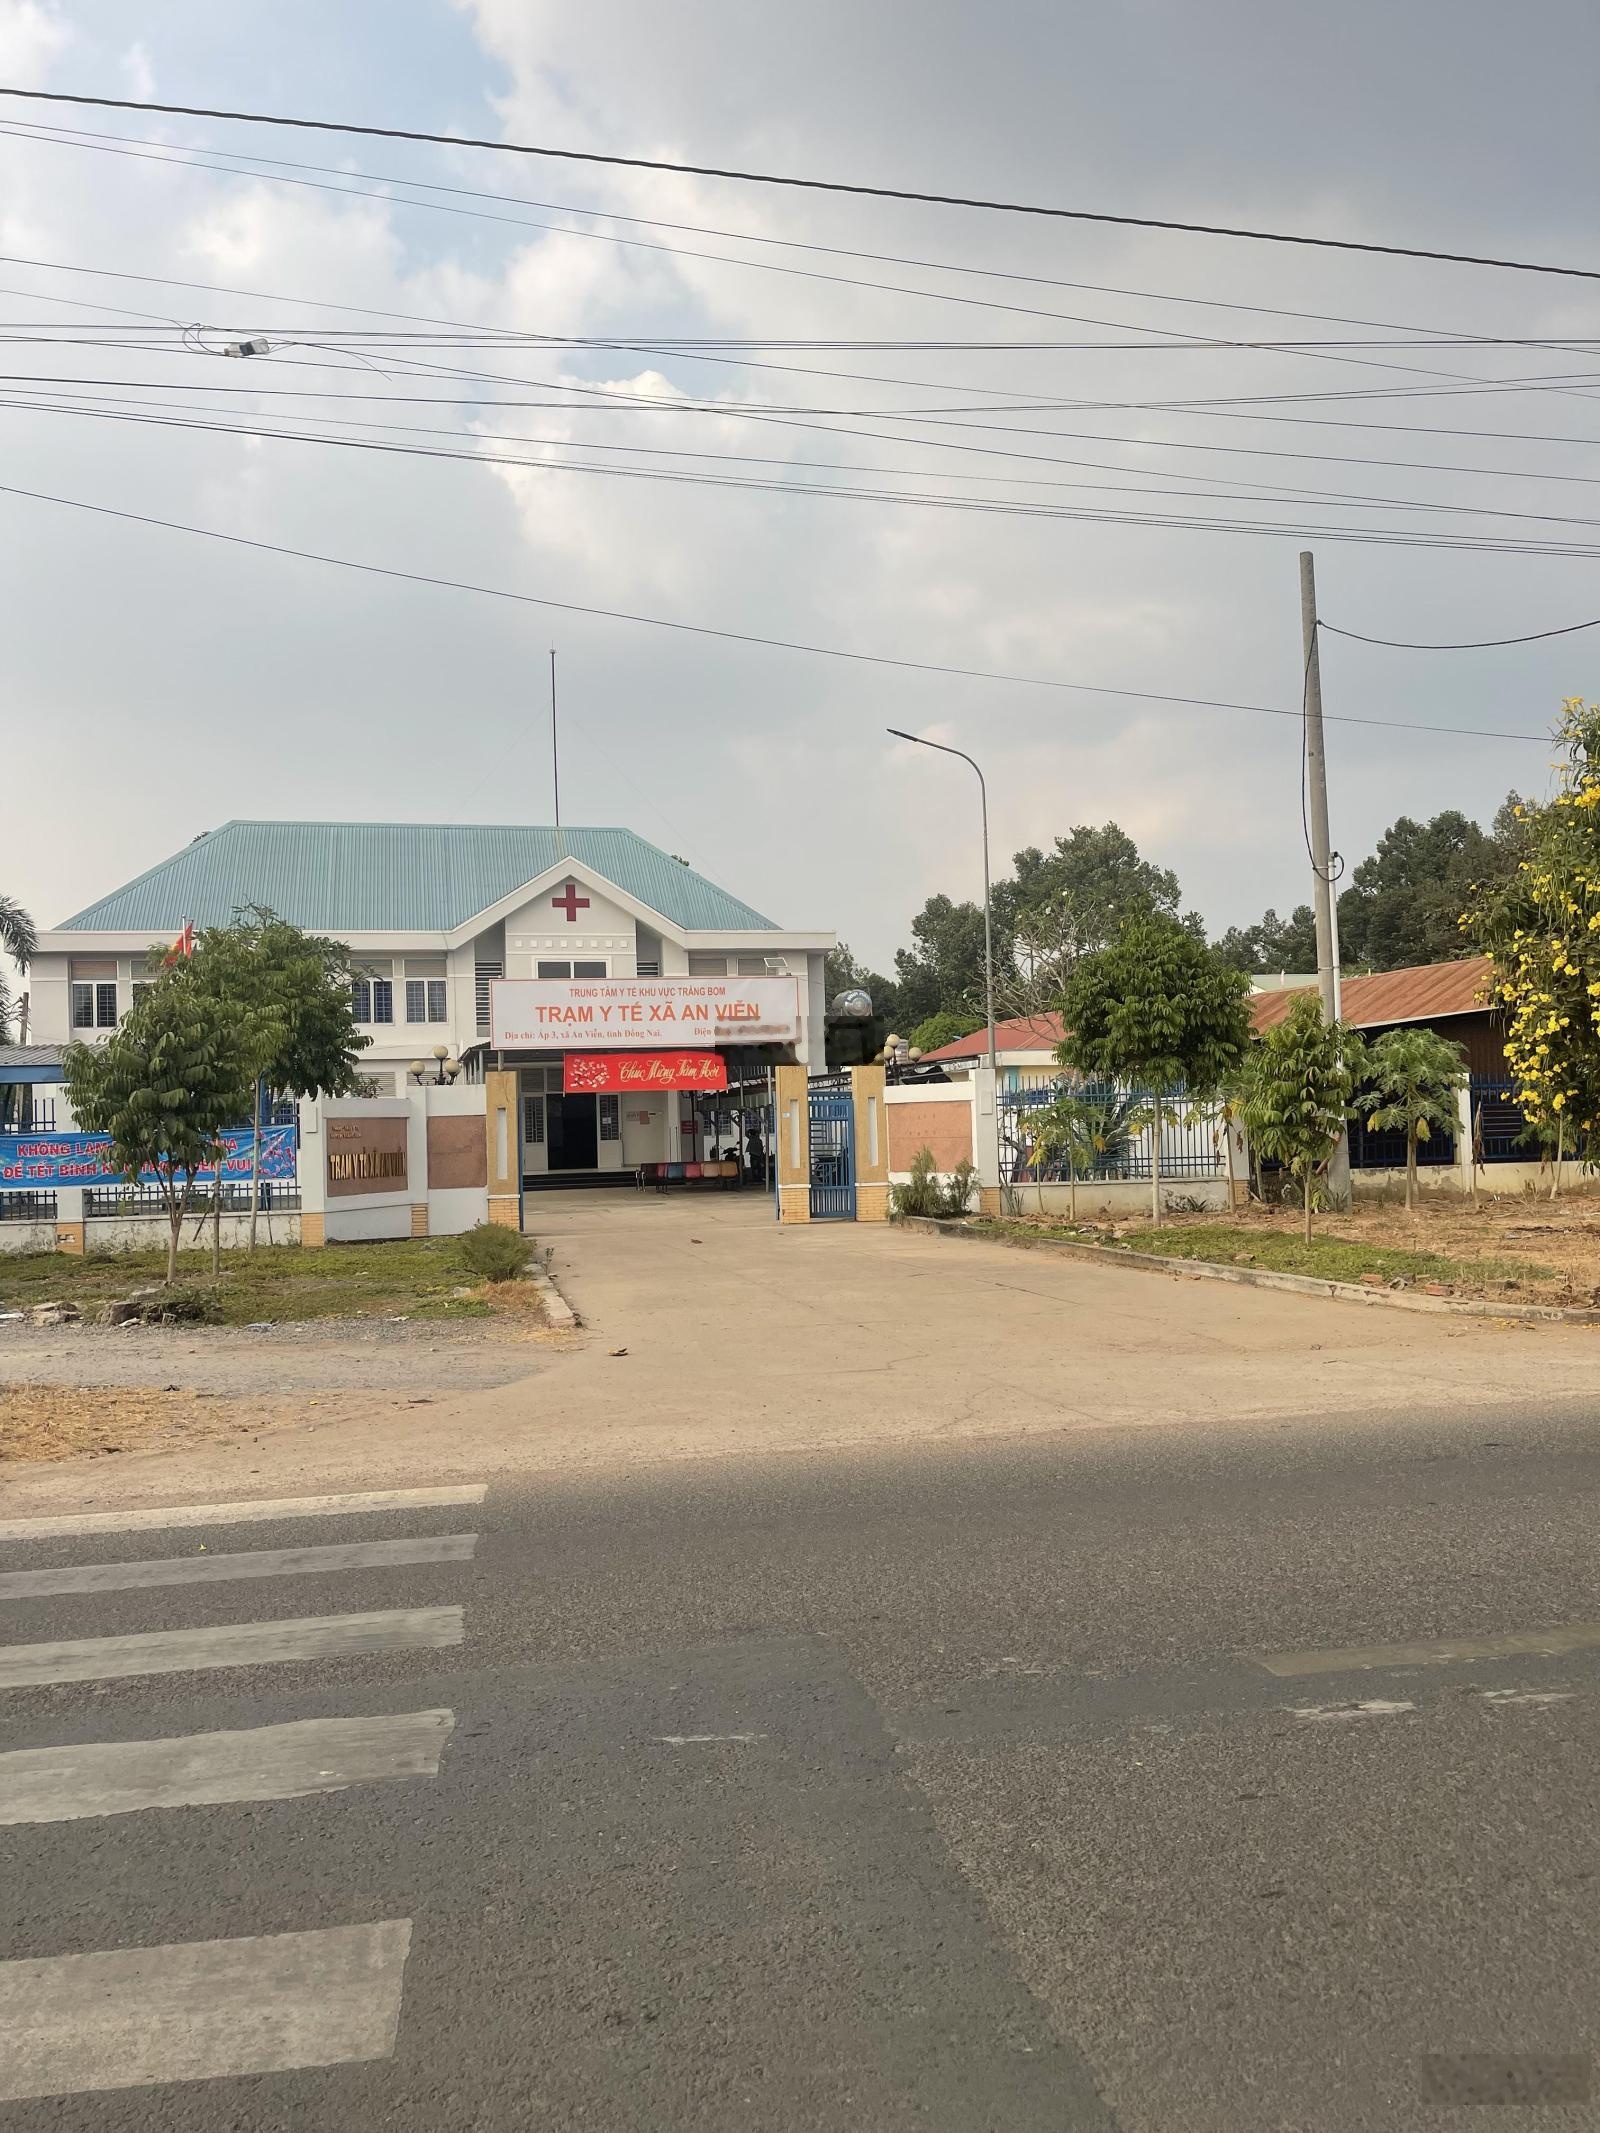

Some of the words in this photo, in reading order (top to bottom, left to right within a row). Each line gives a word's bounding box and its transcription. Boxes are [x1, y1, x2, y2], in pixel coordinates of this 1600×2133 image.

[569, 988, 598, 998] TRUNG
[619, 988, 625, 997] Y
[639, 987, 656, 997] KHU
[707, 987, 726, 996] BOM
[535, 1005, 593, 1027] TRẠM
[599, 1005, 613, 1022] Y
[649, 1000, 676, 1021] XÃ
[681, 1004, 709, 1021] AN
[573, 1031, 583, 1039] An
[618, 1060, 646, 1082] Chúc
[17, 1140, 71, 1157] KHÔNG
[3, 1159, 25, 1178] ĐỂ
[28, 1160, 55, 1178] TẾT
[59, 1159, 97, 1177] BÍNH
[226, 1158, 252, 1172] VUI
